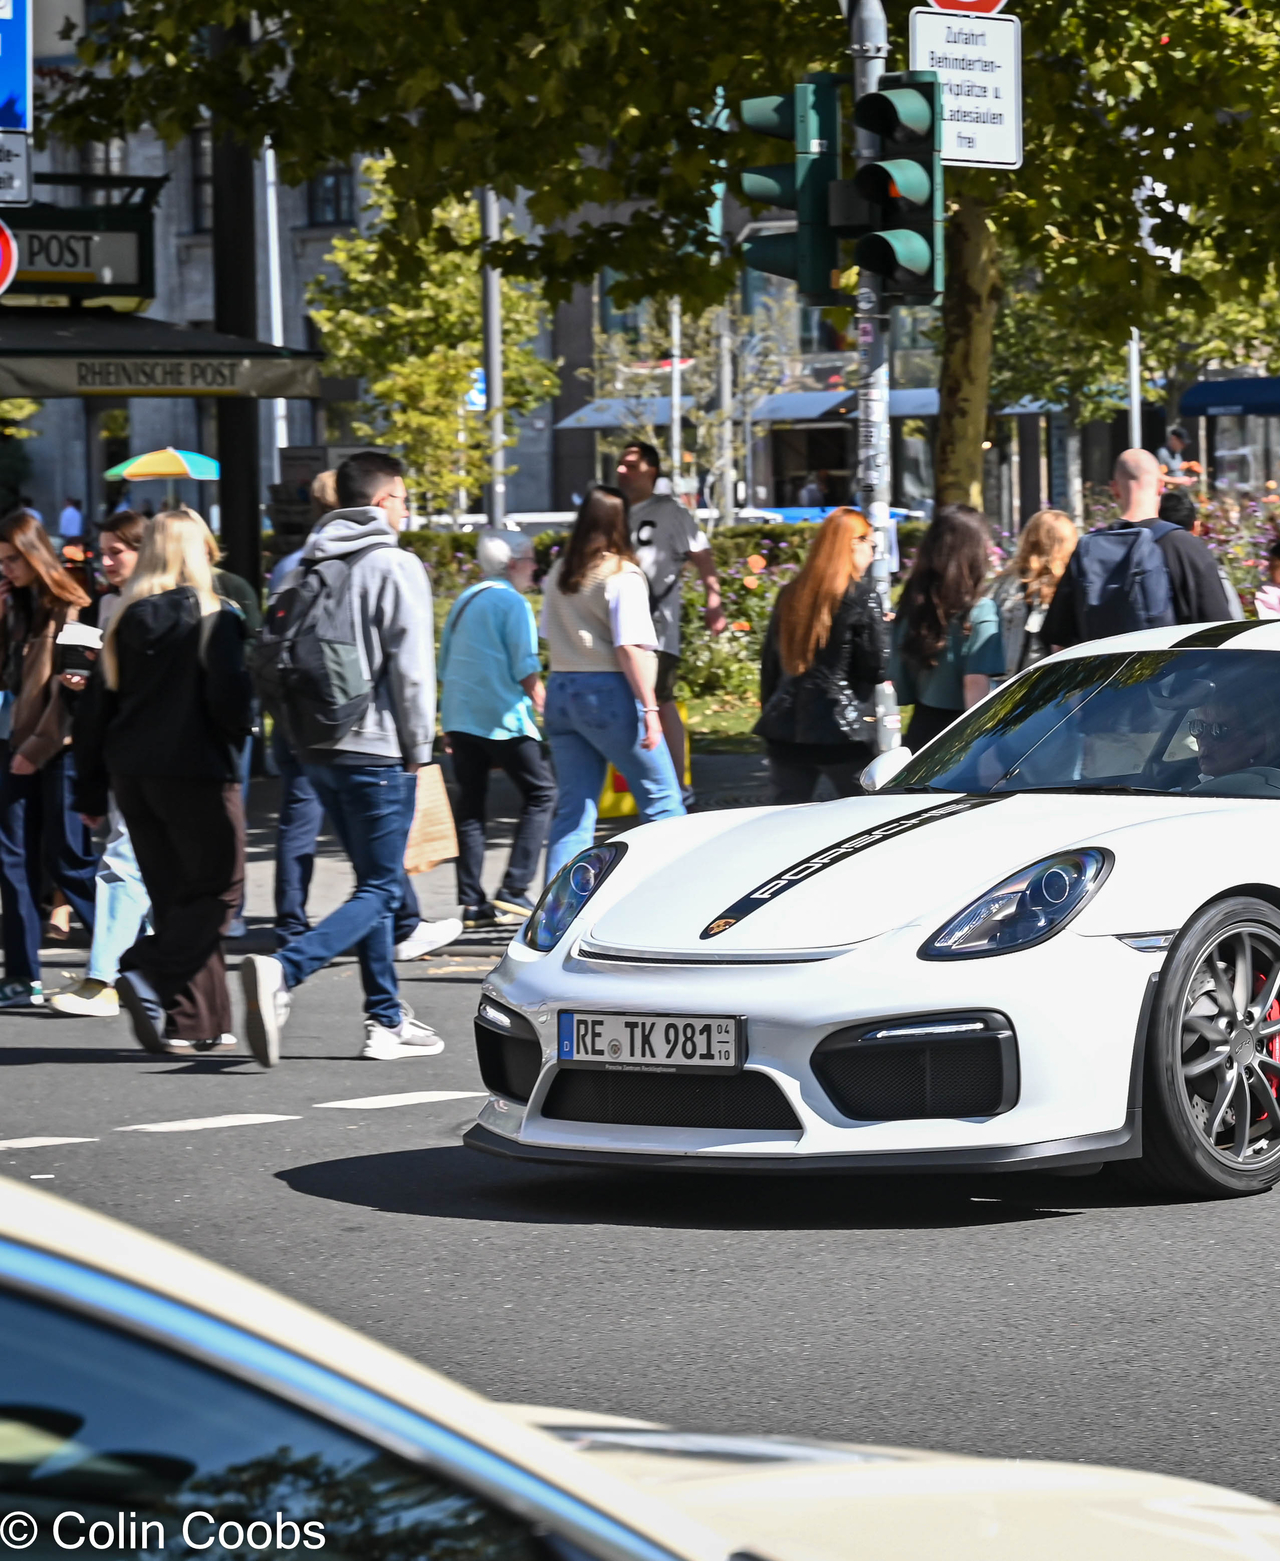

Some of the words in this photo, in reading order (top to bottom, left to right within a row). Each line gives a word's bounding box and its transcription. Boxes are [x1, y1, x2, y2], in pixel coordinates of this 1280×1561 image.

[945, 25, 987, 46] Zufahrt
[929, 51, 1002, 72] Behinderten-
[956, 131, 977, 149] frei
[27, 233, 93, 268] POST
[76, 361, 186, 387] RHEINISCHE
[190, 361, 239, 387] POST
[749, 802, 972, 899] PORSCHE
[576, 1018, 605, 1057] RE
[624, 1021, 656, 1059] TK
[664, 1022, 715, 1061] 981
[716, 1023, 730, 1035] 04
[563, 1041, 570, 1052] D
[717, 1049, 731, 1061] 10
[605, 1063, 622, 1071] Porsche
